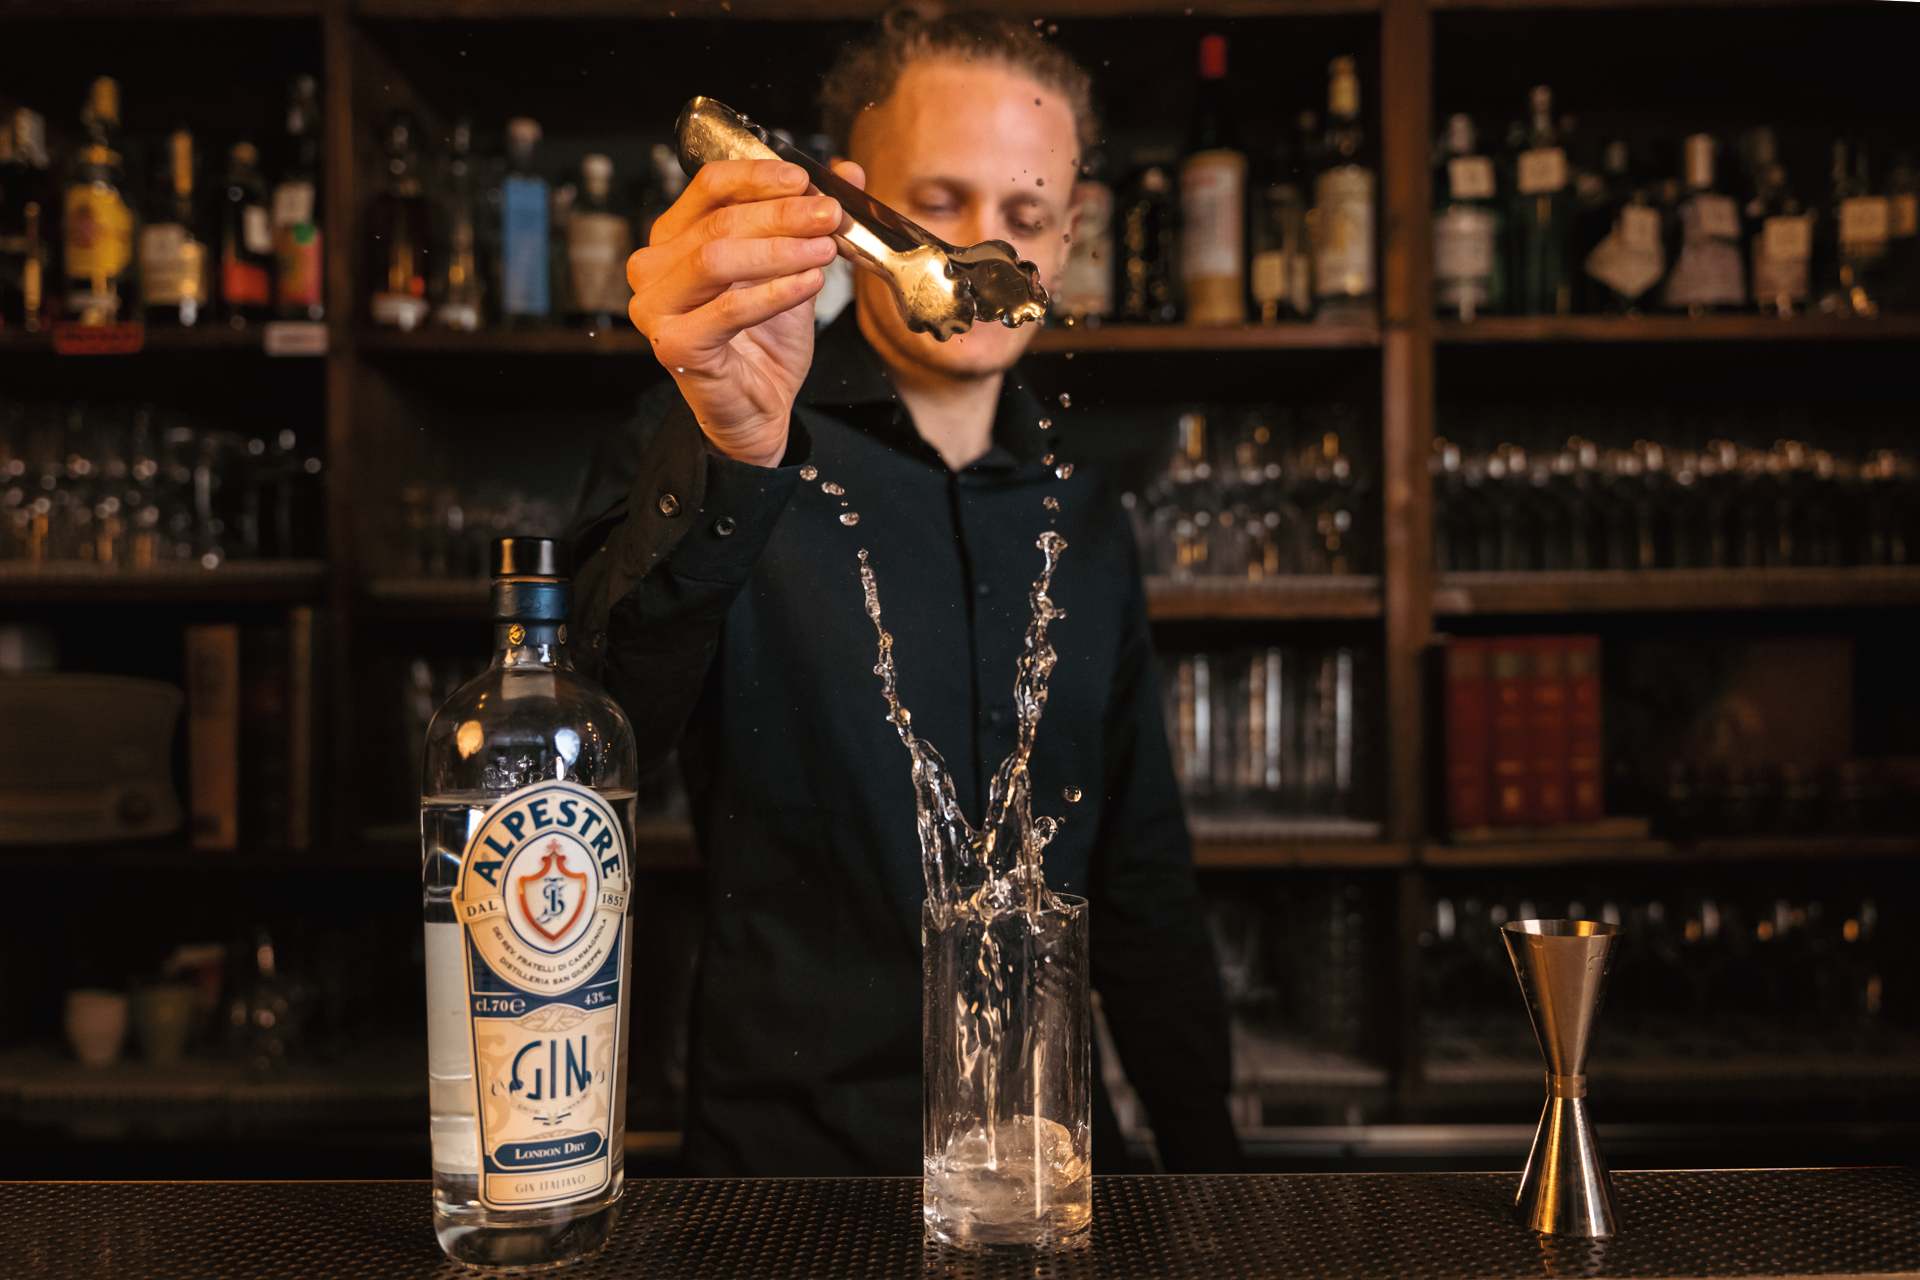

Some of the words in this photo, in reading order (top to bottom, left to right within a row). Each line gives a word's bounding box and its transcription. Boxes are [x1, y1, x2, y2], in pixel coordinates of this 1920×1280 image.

[473, 798, 620, 887] ALPESTRE
[466, 900, 498, 917] DAL
[602, 893, 624, 908] 1857
[493, 926, 503, 941] DEI
[517, 954, 556, 972] FRATELLI
[558, 962, 567, 972] DI
[568, 918, 607, 967] CARMAGNOLA
[499, 957, 549, 985] DISTILLERIA
[553, 975, 570, 985] SAN
[571, 948, 602, 979] GIUSEPPE
[509, 1035, 588, 1100] GIN
[515, 1183, 535, 1193] GIN
[540, 1174, 586, 1191] ITALIANO
